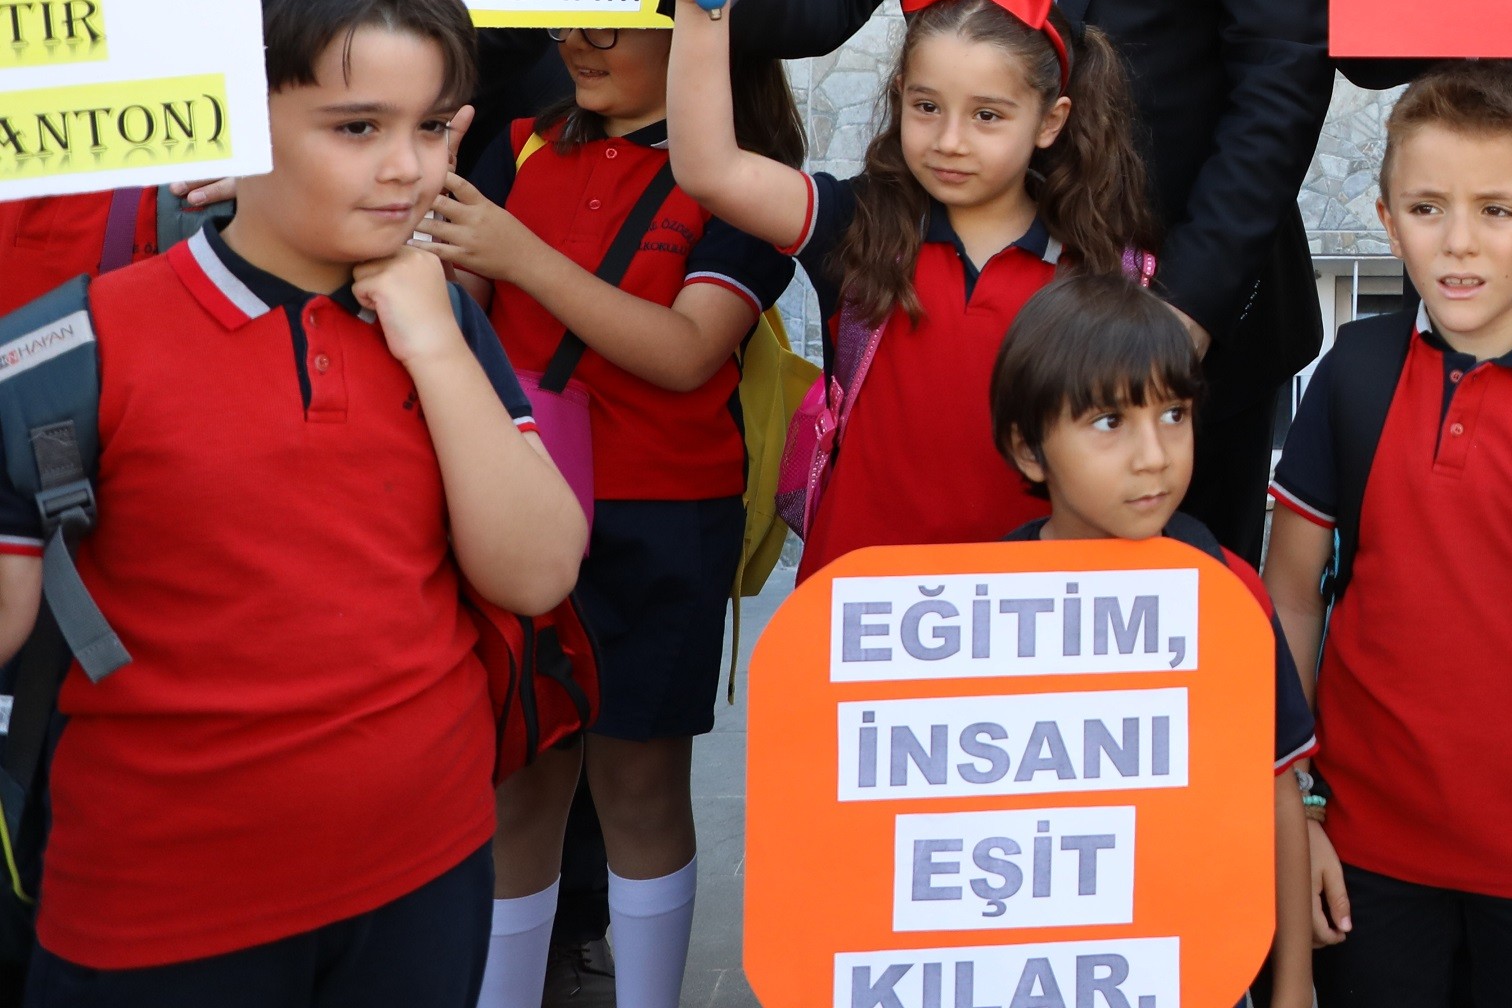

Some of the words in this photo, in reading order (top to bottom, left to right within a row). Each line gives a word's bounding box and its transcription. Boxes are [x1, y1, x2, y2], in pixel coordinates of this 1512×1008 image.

[842, 582, 1186, 669] EĞİTİM,
[858, 710, 1170, 788] İNSANI
[911, 820, 1116, 918] EŞİT
